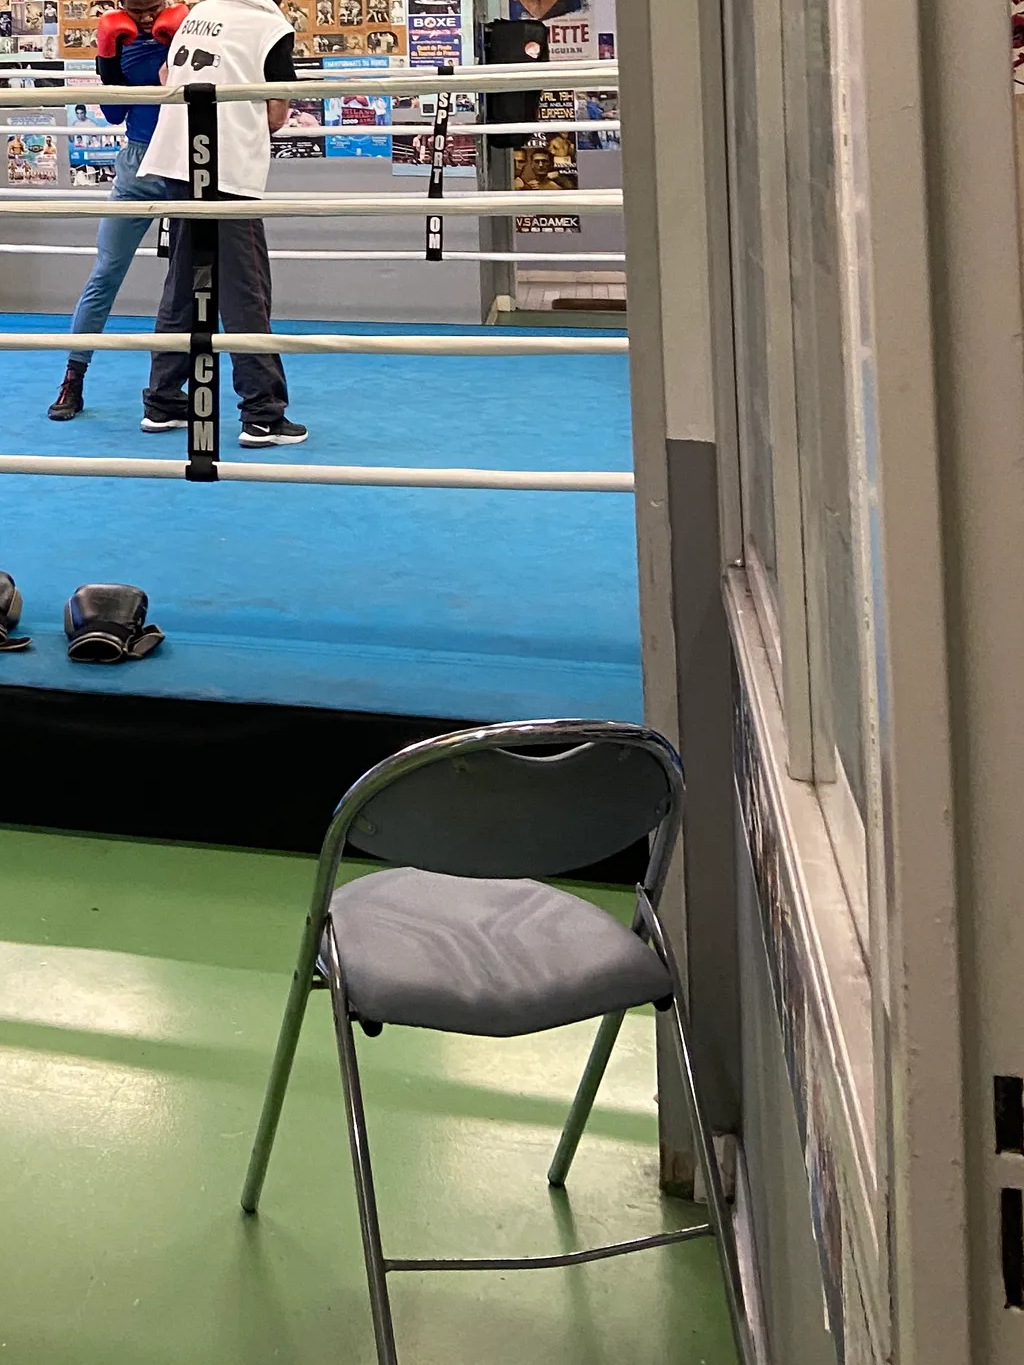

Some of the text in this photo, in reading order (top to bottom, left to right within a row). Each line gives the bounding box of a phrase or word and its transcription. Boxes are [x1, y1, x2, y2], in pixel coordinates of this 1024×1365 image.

[182, 19, 223, 37] BOXING
[414, 17, 457, 28] BOXE
[433, 92, 449, 184] SPORT
[193, 134, 212, 322] SPT
[429, 217, 441, 249] OM
[532, 217, 578, 226] ADAMEK
[193, 353, 214, 452] COM
